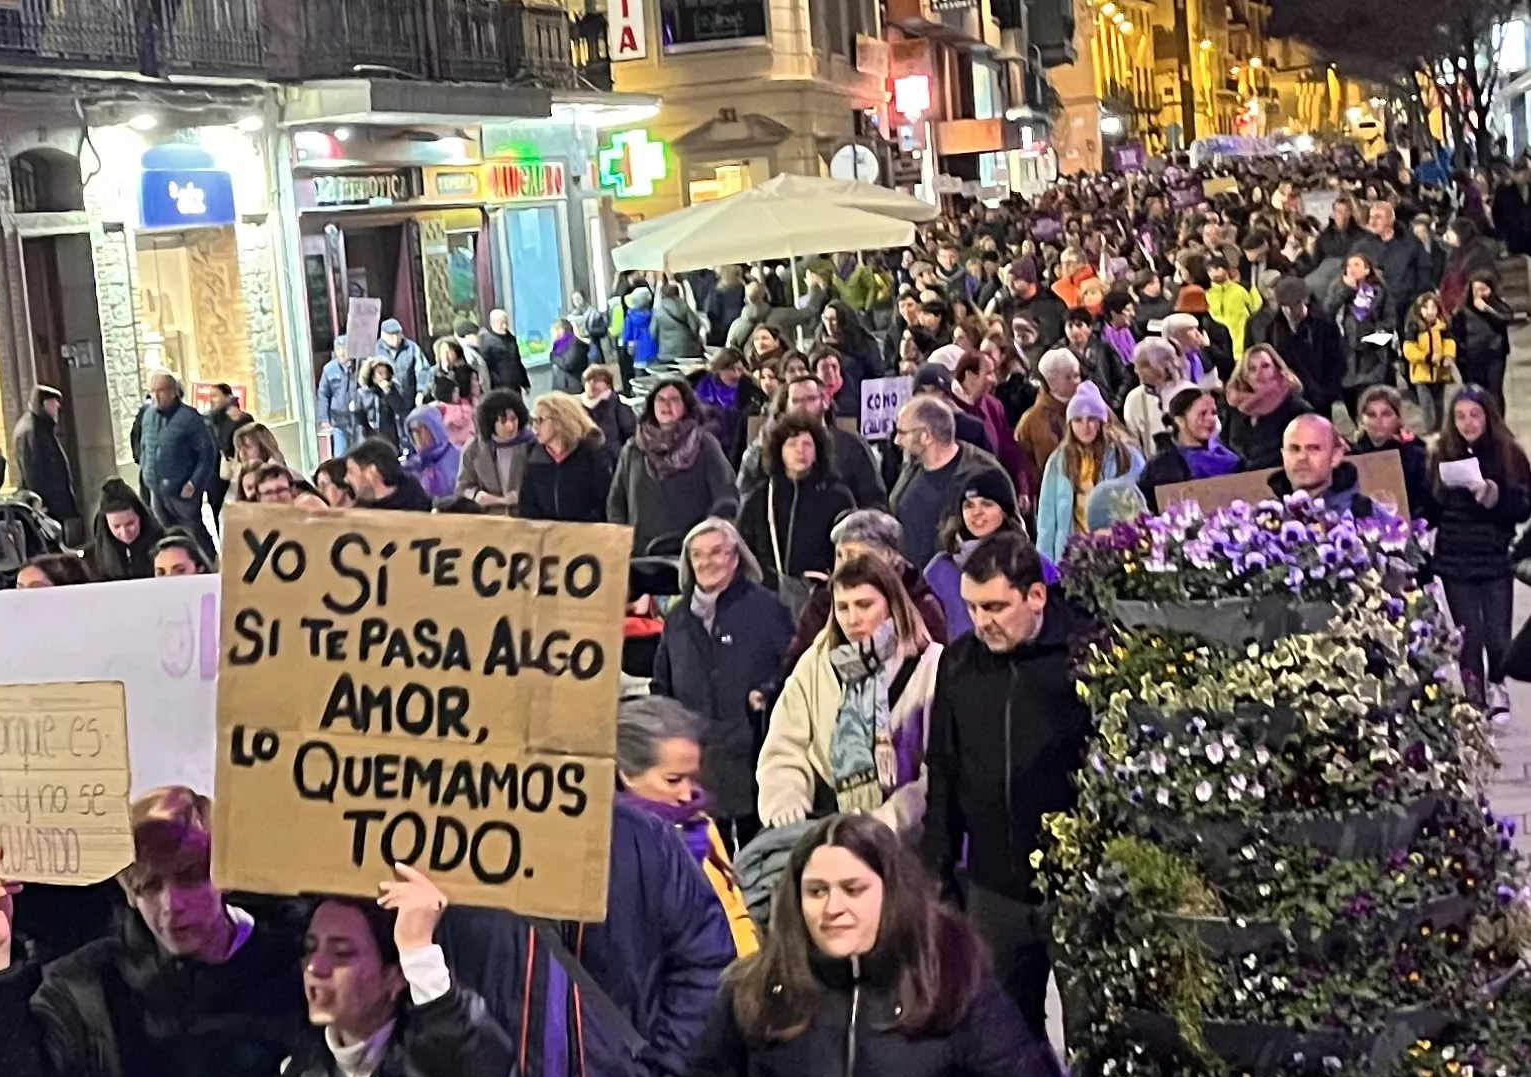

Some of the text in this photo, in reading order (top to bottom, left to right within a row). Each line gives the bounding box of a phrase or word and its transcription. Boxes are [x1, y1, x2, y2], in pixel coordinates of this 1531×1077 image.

[242, 527, 307, 585] YO
[410, 537, 463, 587] TE
[472, 545, 602, 598] CREO
[228, 607, 280, 666] SI
[300, 617, 348, 662] TE
[359, 616, 472, 672] PASA
[483, 615, 605, 680] ALGO
[319, 672, 489, 745] AMOR,
[37, 784, 69, 814] no
[230, 724, 588, 817] LO QUEMAMOS
[343, 810, 535, 885] TODO.
